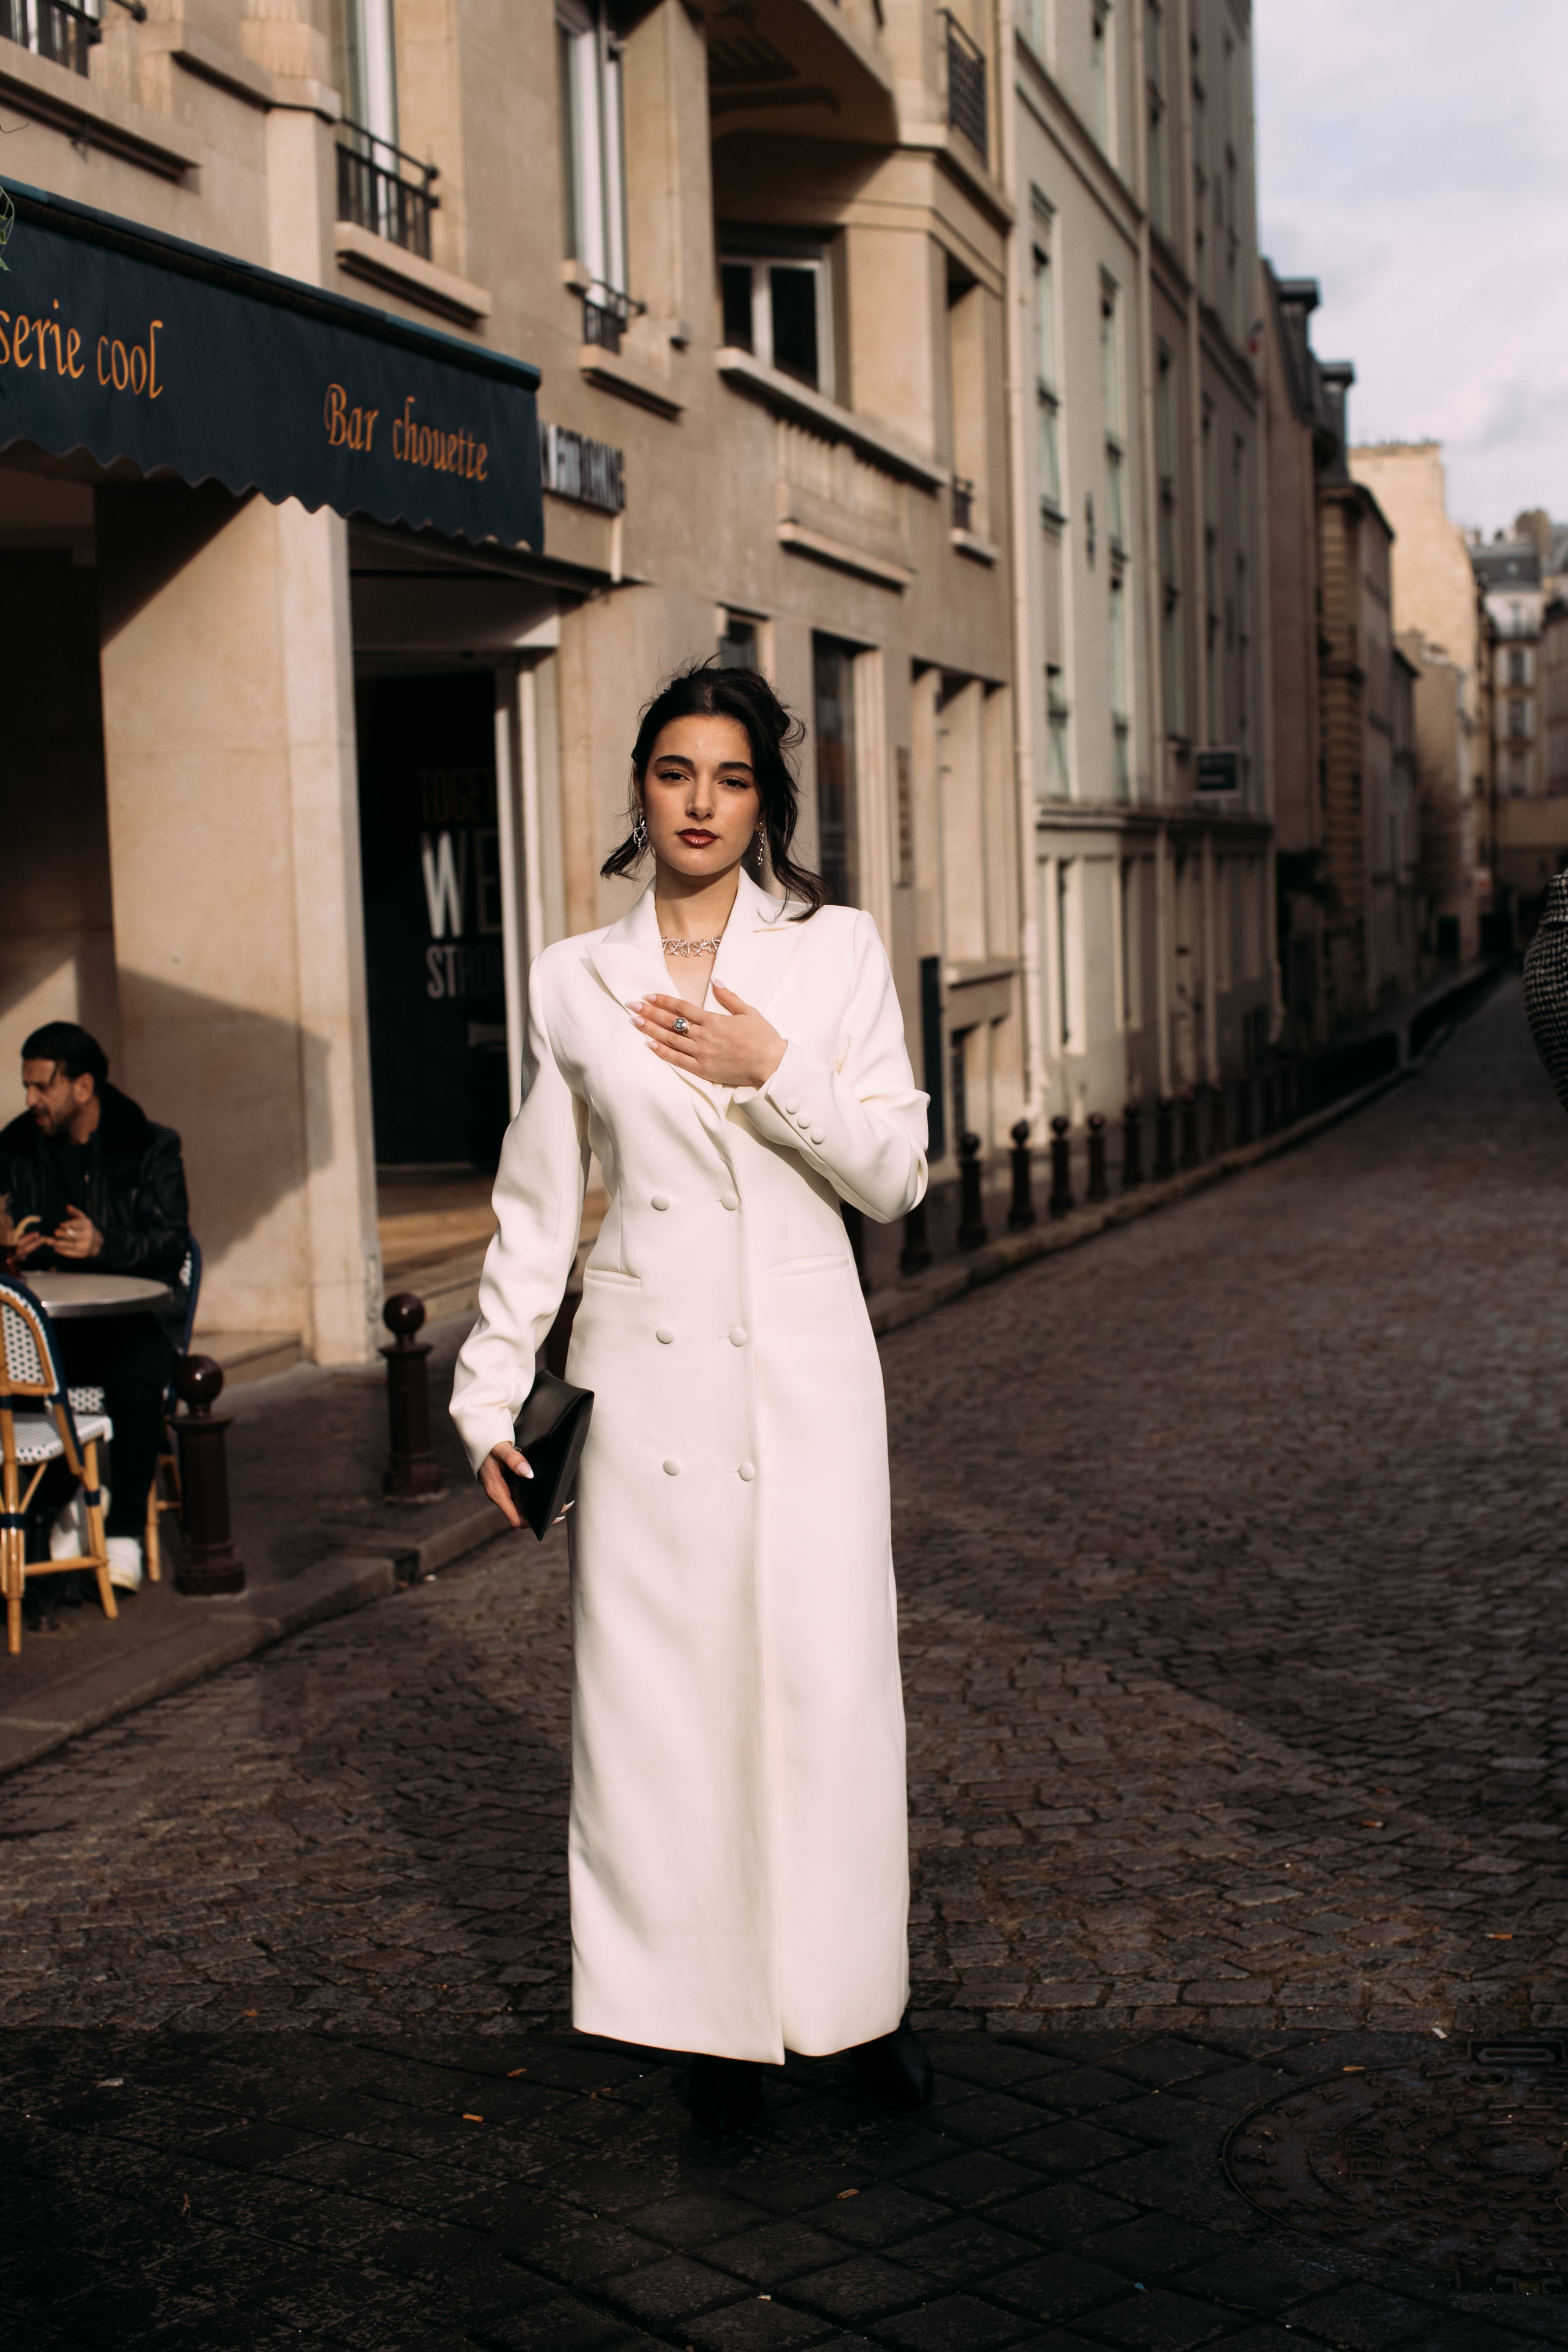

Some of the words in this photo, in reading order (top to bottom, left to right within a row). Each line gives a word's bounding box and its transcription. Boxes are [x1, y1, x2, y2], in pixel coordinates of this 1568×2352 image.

[96, 319, 164, 399] cool
[323, 383, 380, 451] Bar
[392, 395, 488, 482] chouette
[420, 827, 502, 940] WE
